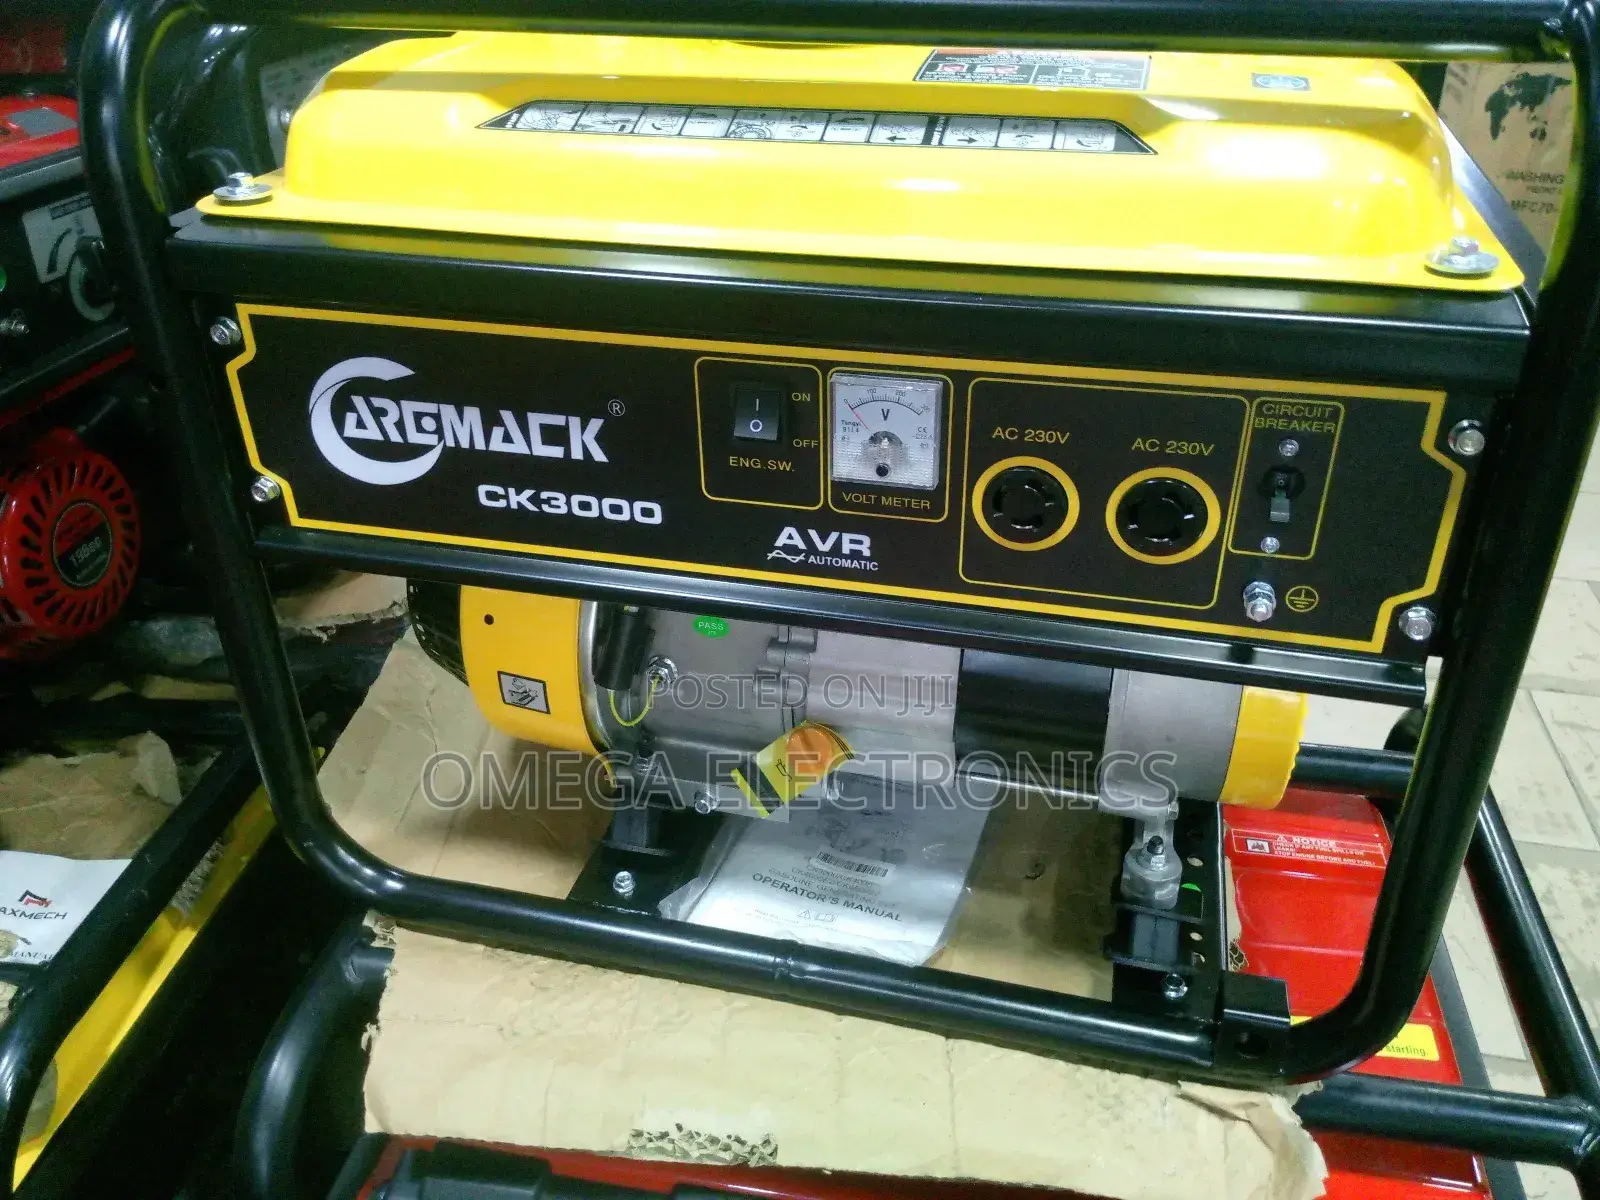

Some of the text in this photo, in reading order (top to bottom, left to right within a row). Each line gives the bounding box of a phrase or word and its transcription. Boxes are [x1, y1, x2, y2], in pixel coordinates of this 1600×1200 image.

[791, 392, 811, 402] ON
[881, 408, 890, 421] V
[1262, 403, 1335, 419] CIRCUIT
[1254, 417, 1336, 433] BREAKER
[793, 438, 819, 449] OFF
[992, 426, 1070, 446] AC 230V
[1131, 437, 1214, 457] AC 230V
[477, 484, 663, 525] CK3000
[841, 491, 931, 510] VOLT METER
[774, 526, 871, 557] AVR
[807, 554, 879, 571] AUTOMATIC
[698, 621, 724, 631] PASS
[1292, 836, 1338, 849] NOTICE
[752, 872, 839, 905] OPERATOR'S
[842, 899, 903, 922] MANUAL
[1386, 1045, 1429, 1057] starting.
